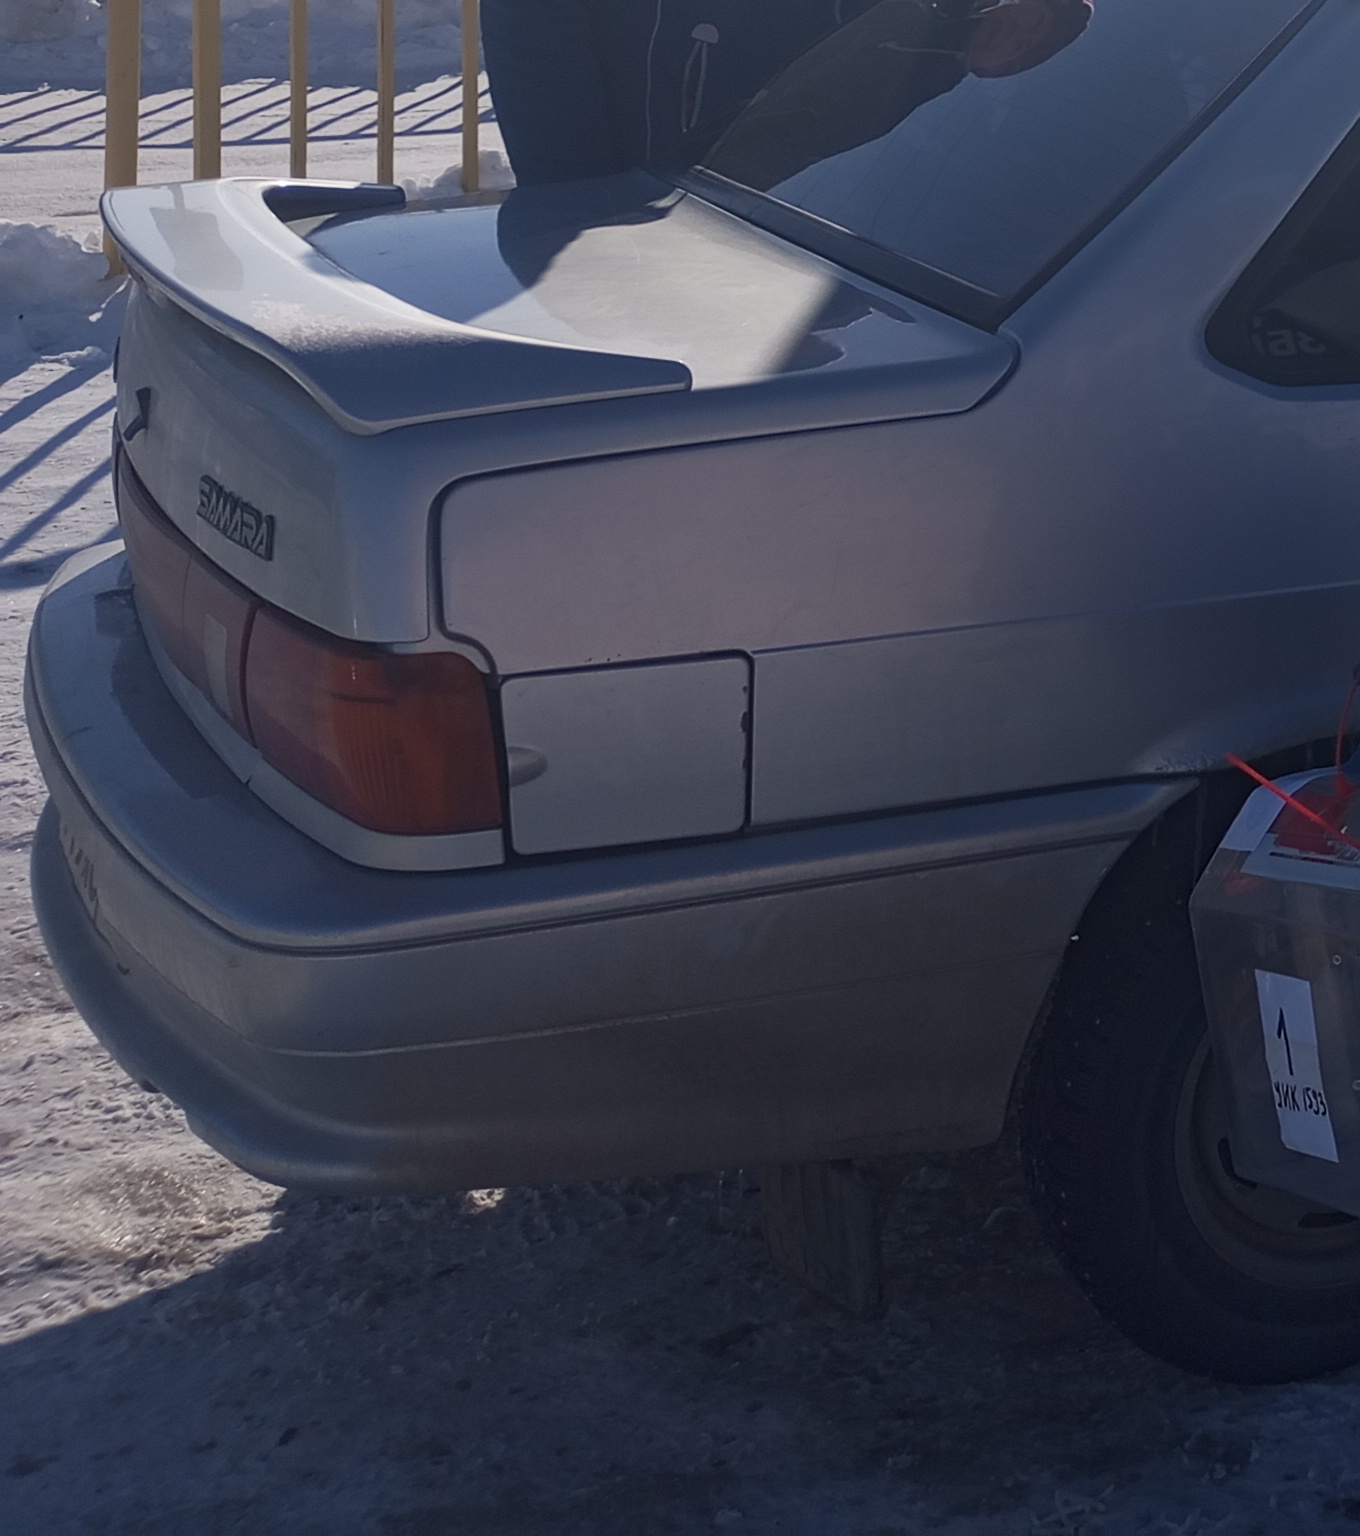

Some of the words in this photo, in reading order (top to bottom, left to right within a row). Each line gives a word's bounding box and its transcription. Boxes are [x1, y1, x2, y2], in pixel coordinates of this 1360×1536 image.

[196, 474, 275, 562] SAMARA
[1276, 1007, 1294, 1077] 1
[1274, 1079, 1301, 1112] УИК
[1302, 1086, 1327, 1116] 1593
